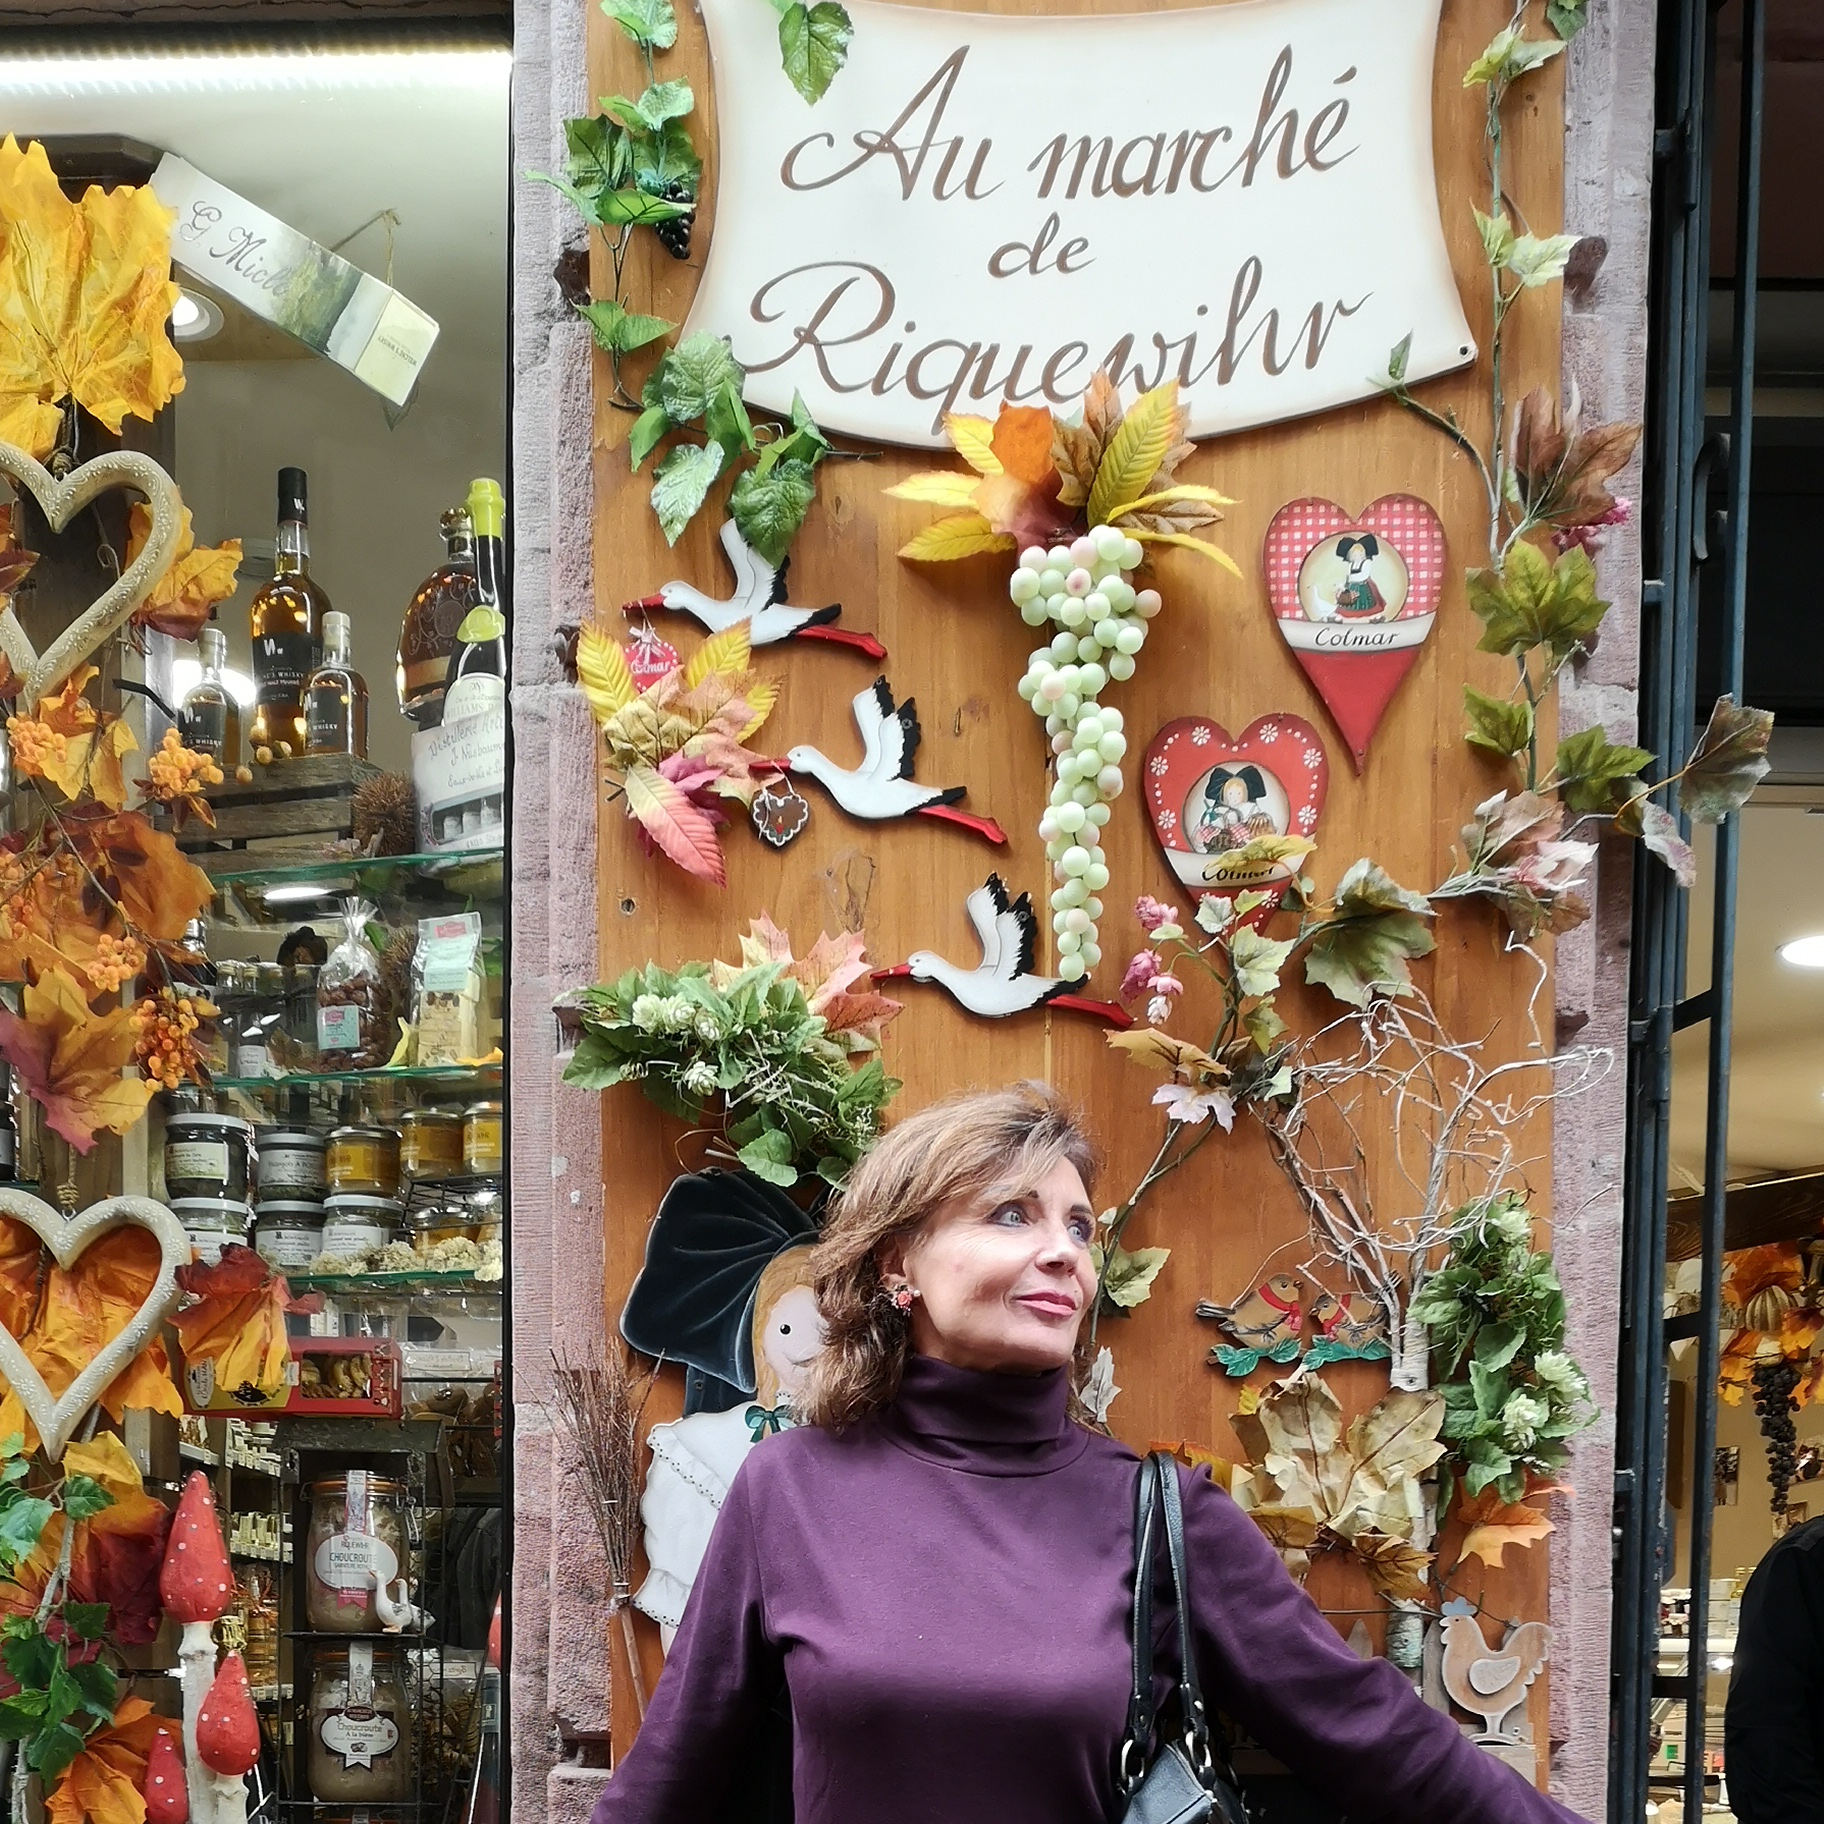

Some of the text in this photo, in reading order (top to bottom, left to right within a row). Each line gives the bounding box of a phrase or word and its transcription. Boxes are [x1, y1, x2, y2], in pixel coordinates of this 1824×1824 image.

[779, 44, 1362, 203] Au marché
[987, 212, 1097, 279] de
[741, 254, 1374, 434] Riquewihr
[1315, 627, 1400, 646] Colmar
[337, 1722, 382, 1733] Choucroute
